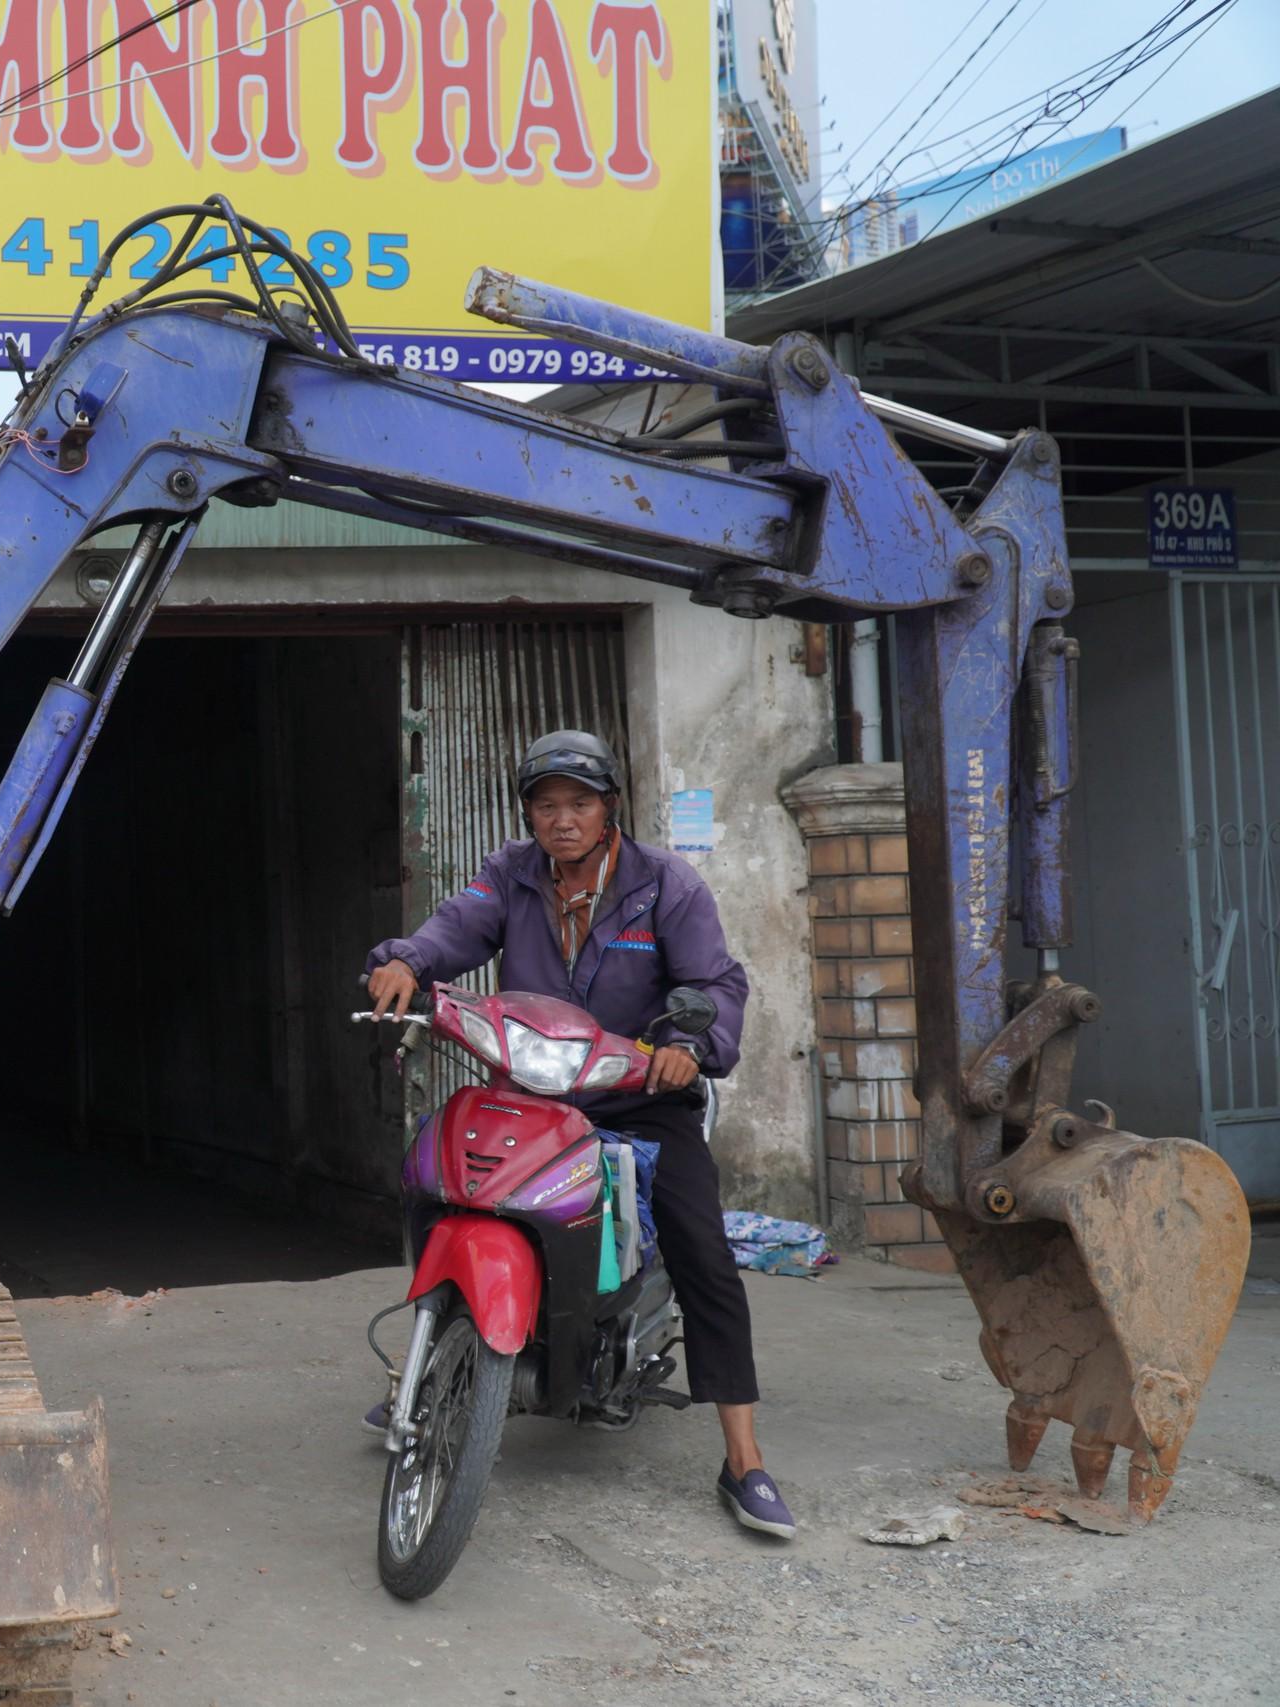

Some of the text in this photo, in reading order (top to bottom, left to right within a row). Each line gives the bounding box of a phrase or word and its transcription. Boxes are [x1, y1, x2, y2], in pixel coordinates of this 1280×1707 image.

[403, 345, 459, 371] 819
[488, 348, 562, 375] 0979
[570, 350, 626, 376] 934
[1154, 491, 1231, 530] 369A
